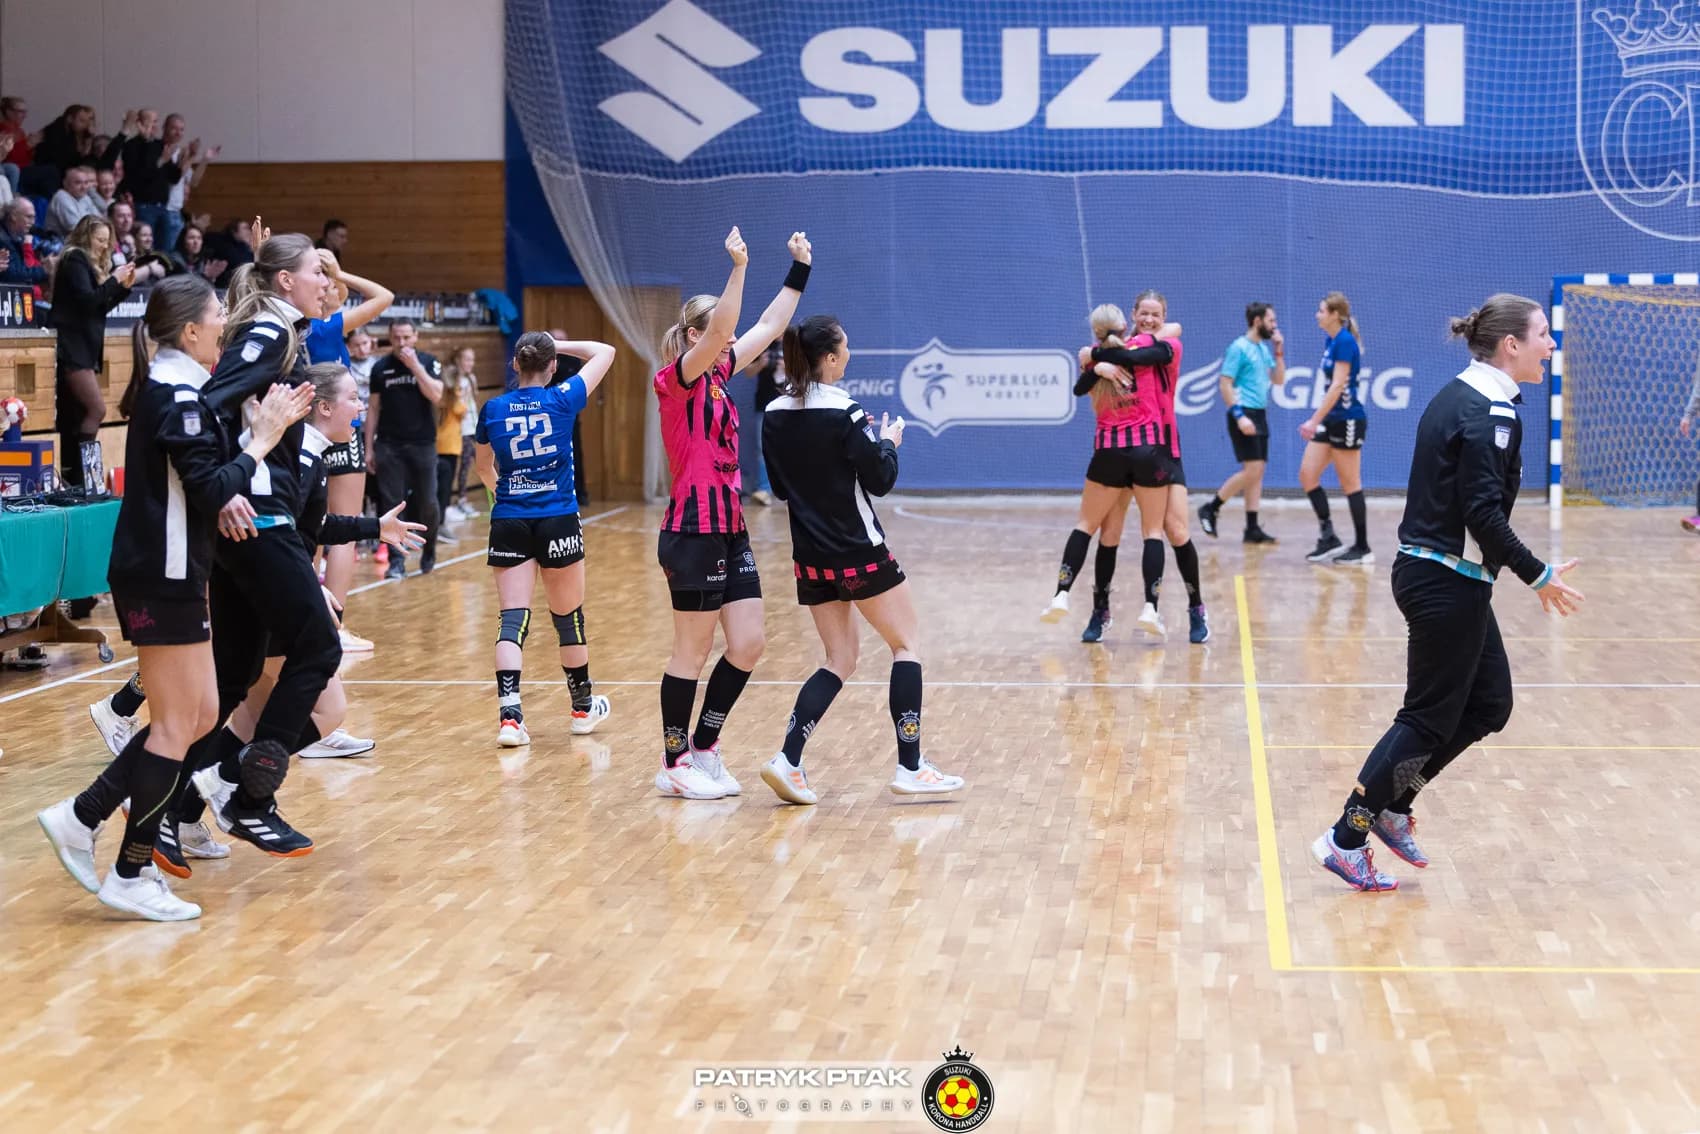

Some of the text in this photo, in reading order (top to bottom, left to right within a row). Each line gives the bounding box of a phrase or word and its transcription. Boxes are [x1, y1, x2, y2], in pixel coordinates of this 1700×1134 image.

[799, 24, 1464, 132] SUZUKI
[965, 374, 1059, 386] SUPERLIGA
[1250, 367, 1413, 410] GiG
[505, 413, 557, 460] 22
